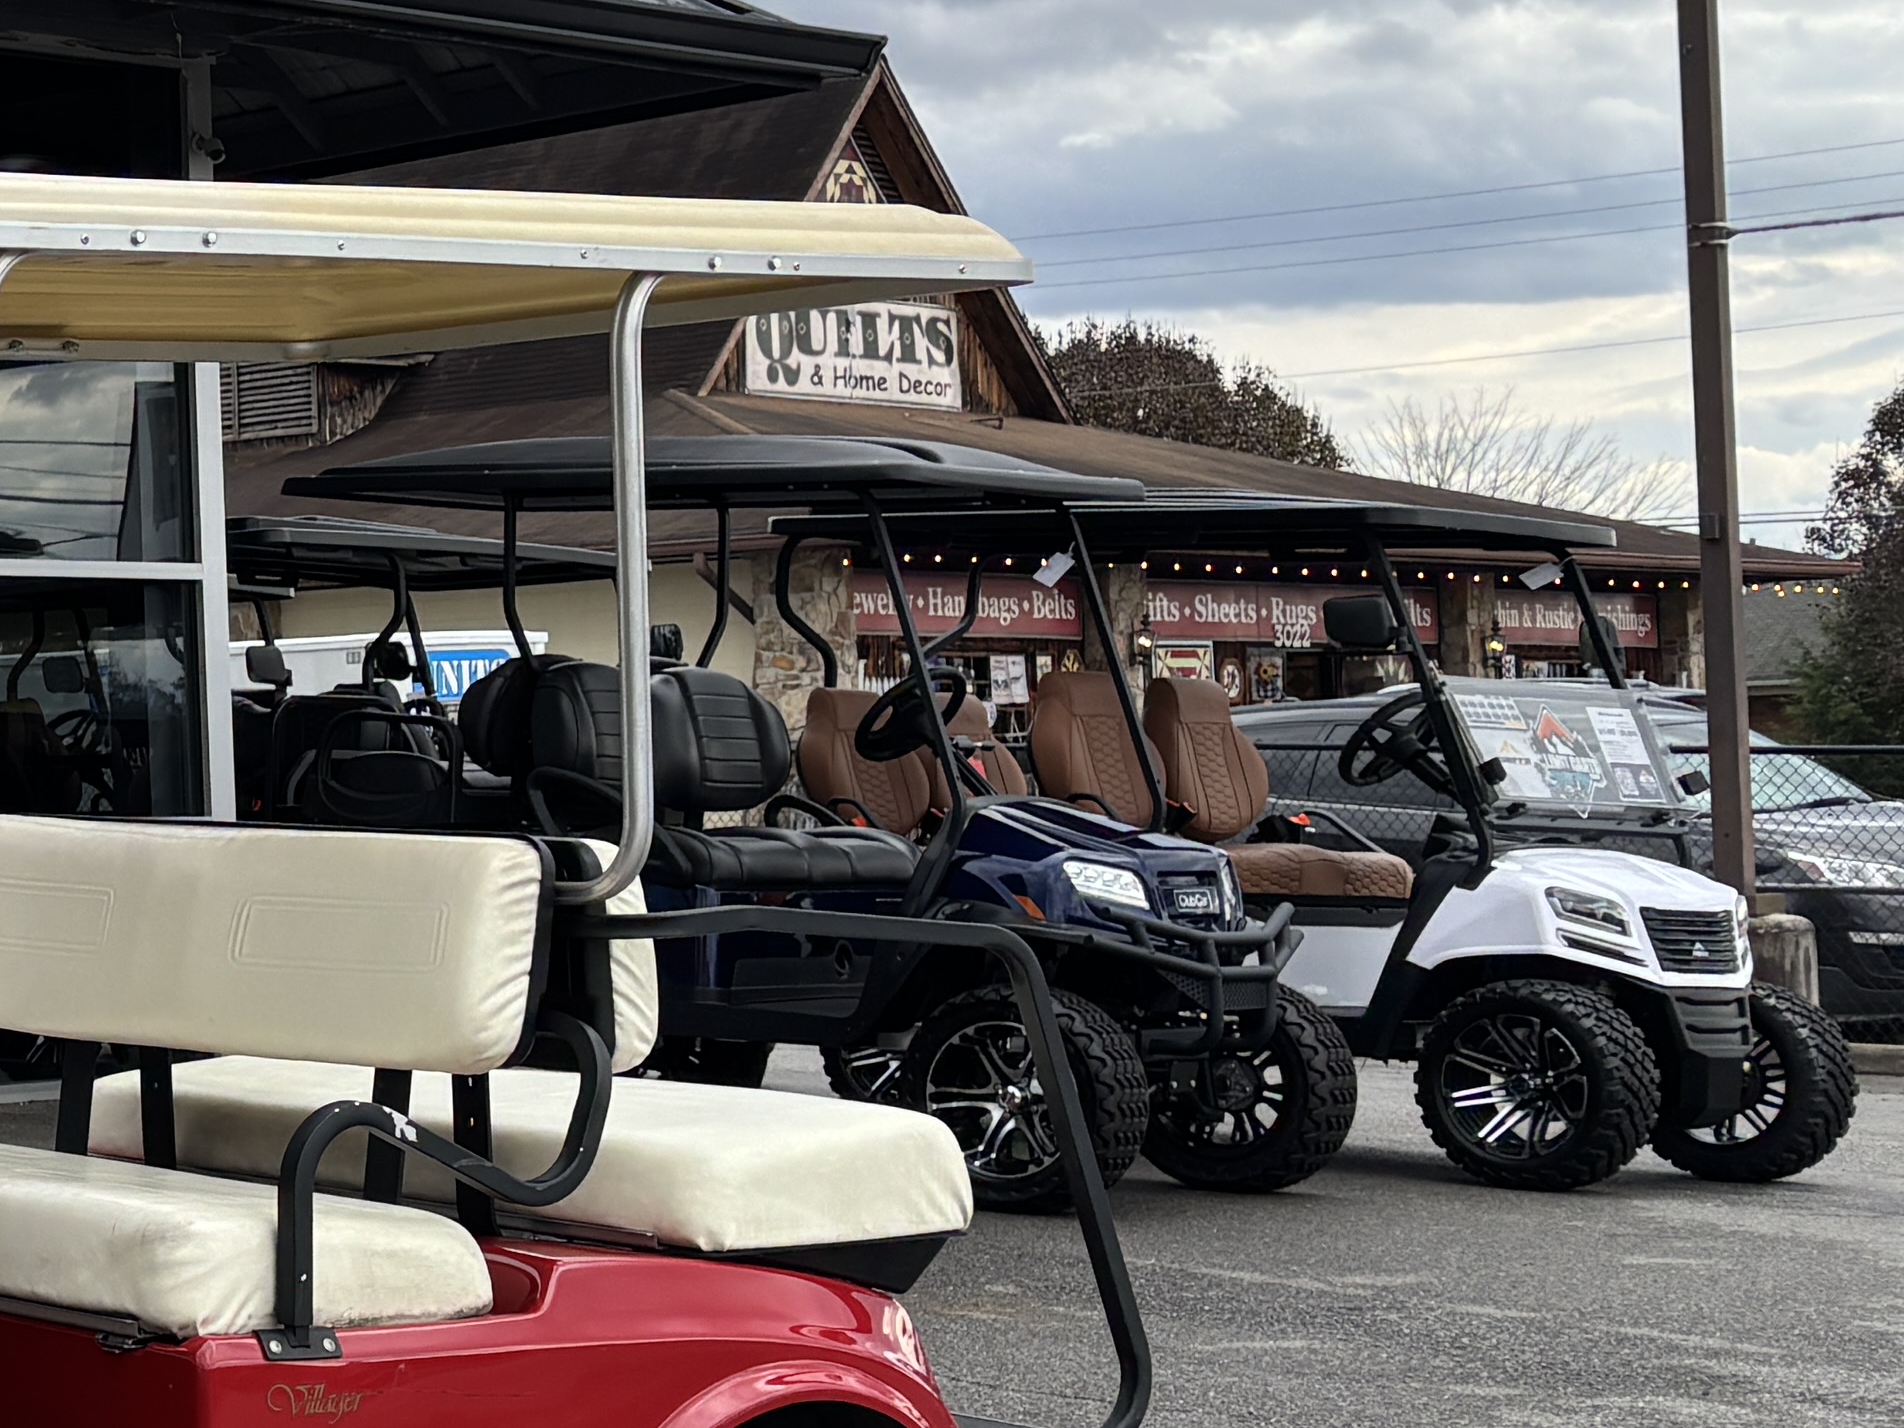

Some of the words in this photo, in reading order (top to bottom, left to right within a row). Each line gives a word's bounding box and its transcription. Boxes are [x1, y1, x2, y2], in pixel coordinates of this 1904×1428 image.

[755, 308, 954, 387] QUILTS
[810, 363, 824, 387] &
[833, 364, 889, 392] Home
[898, 371, 952, 398] Decor
[927, 586, 1020, 626] Hanbags
[1032, 587, 1076, 620] Belts
[1143, 591, 1180, 622] ifts
[1195, 593, 1258, 624] Sheets
[1270, 596, 1318, 626] Rugs
[1494, 600, 1520, 628] bin
[1522, 602, 1533, 628] &
[1535, 602, 1576, 630] Rustic
[1273, 623, 1312, 649] 3022
[267, 1383, 365, 1425] Villager
